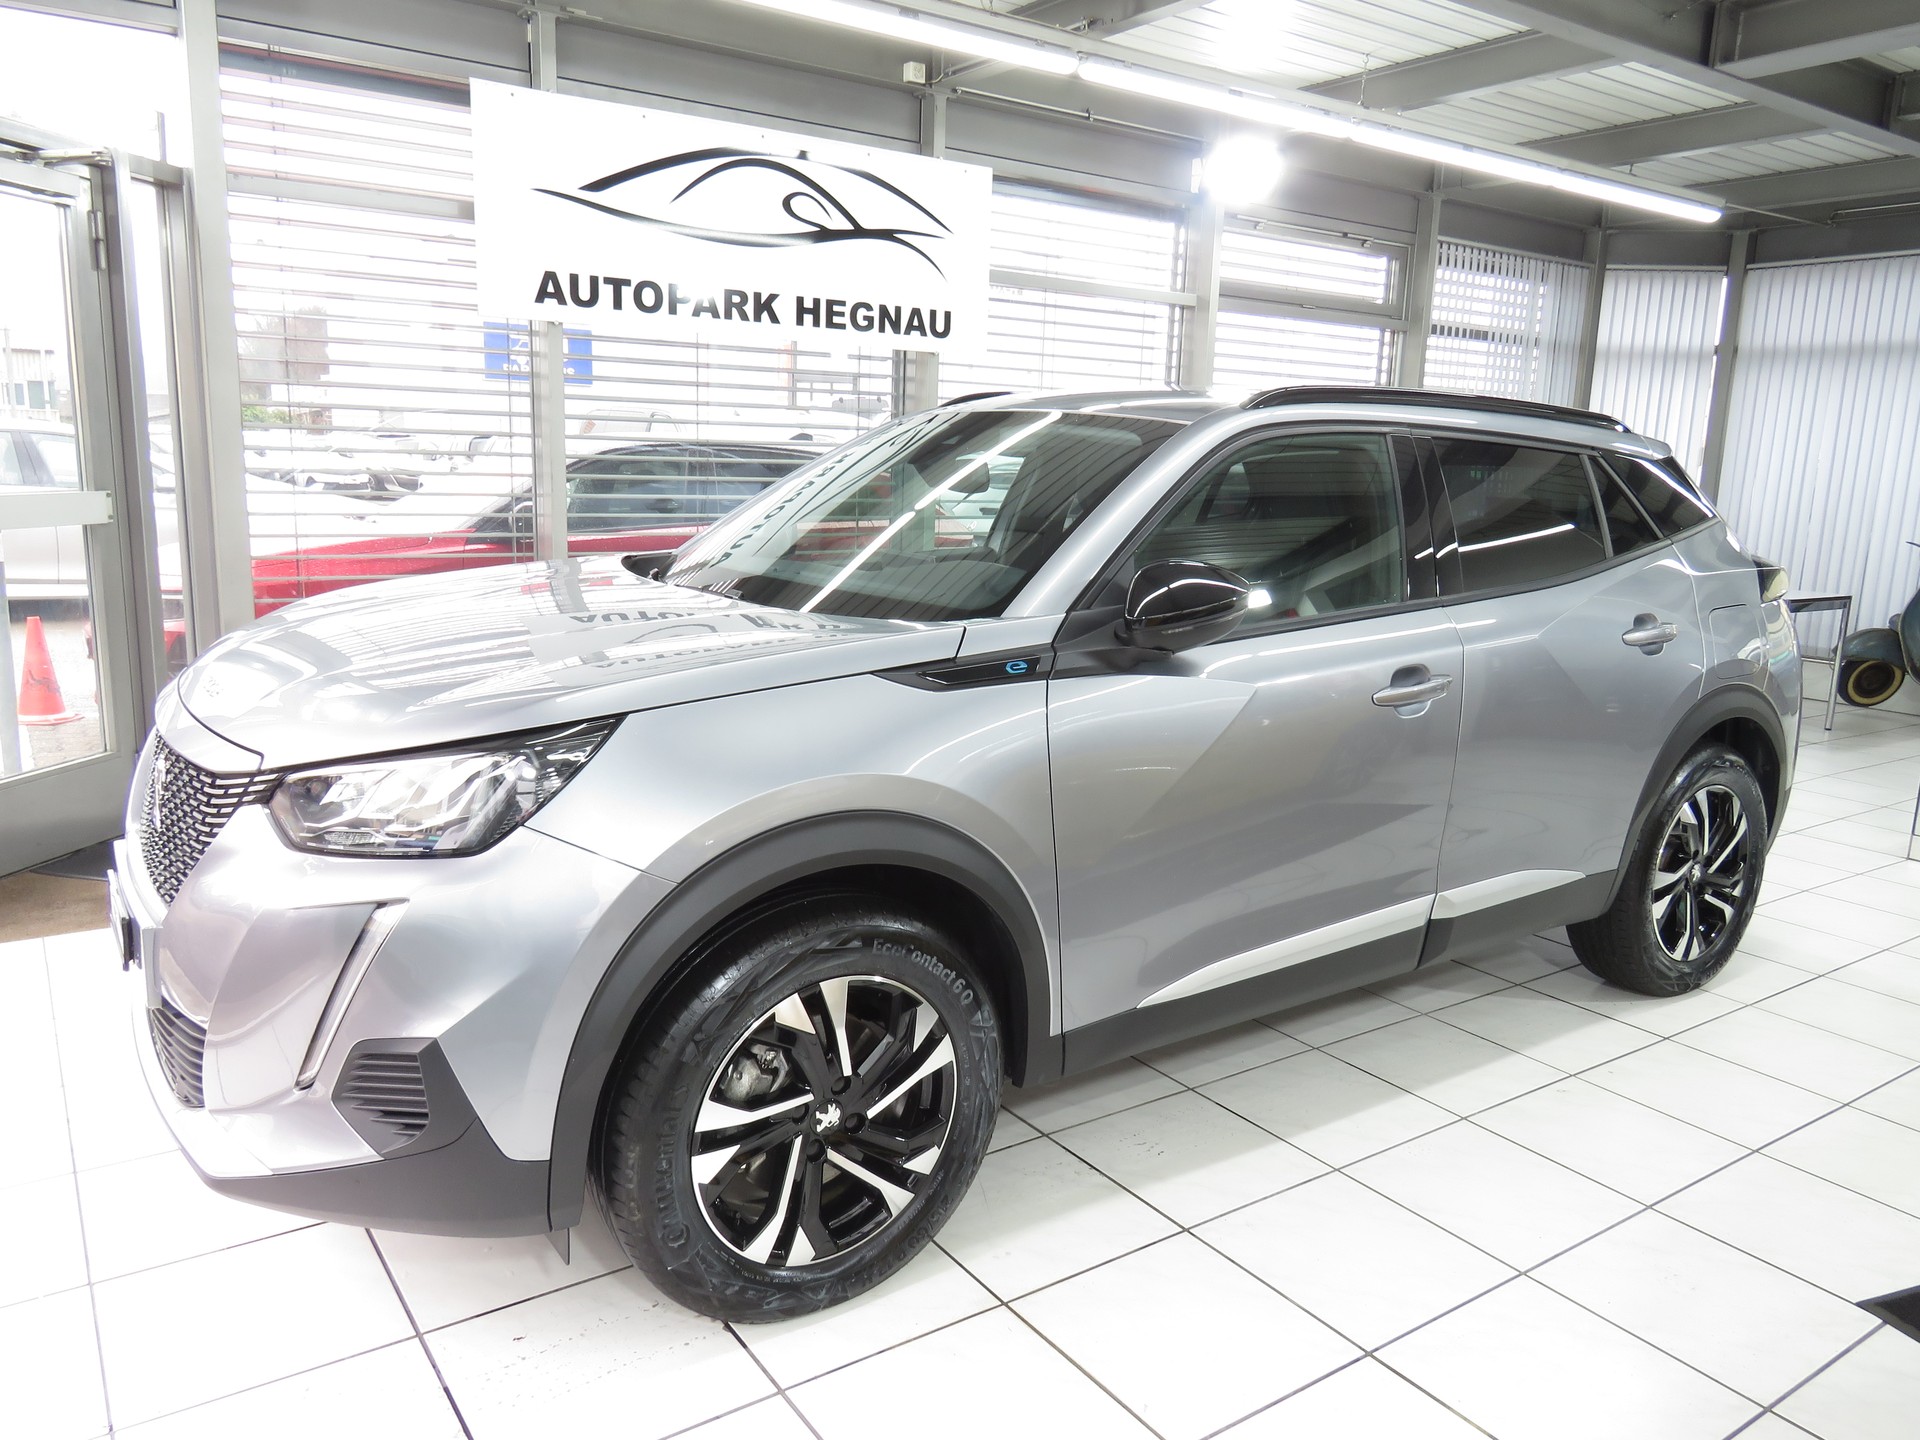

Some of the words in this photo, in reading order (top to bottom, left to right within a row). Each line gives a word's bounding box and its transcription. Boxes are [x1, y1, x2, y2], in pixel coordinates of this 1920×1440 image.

[535, 271, 780, 323] AUTOPARK
[796, 296, 951, 338] HEGNAU
[953, 978, 966, 994] 6
